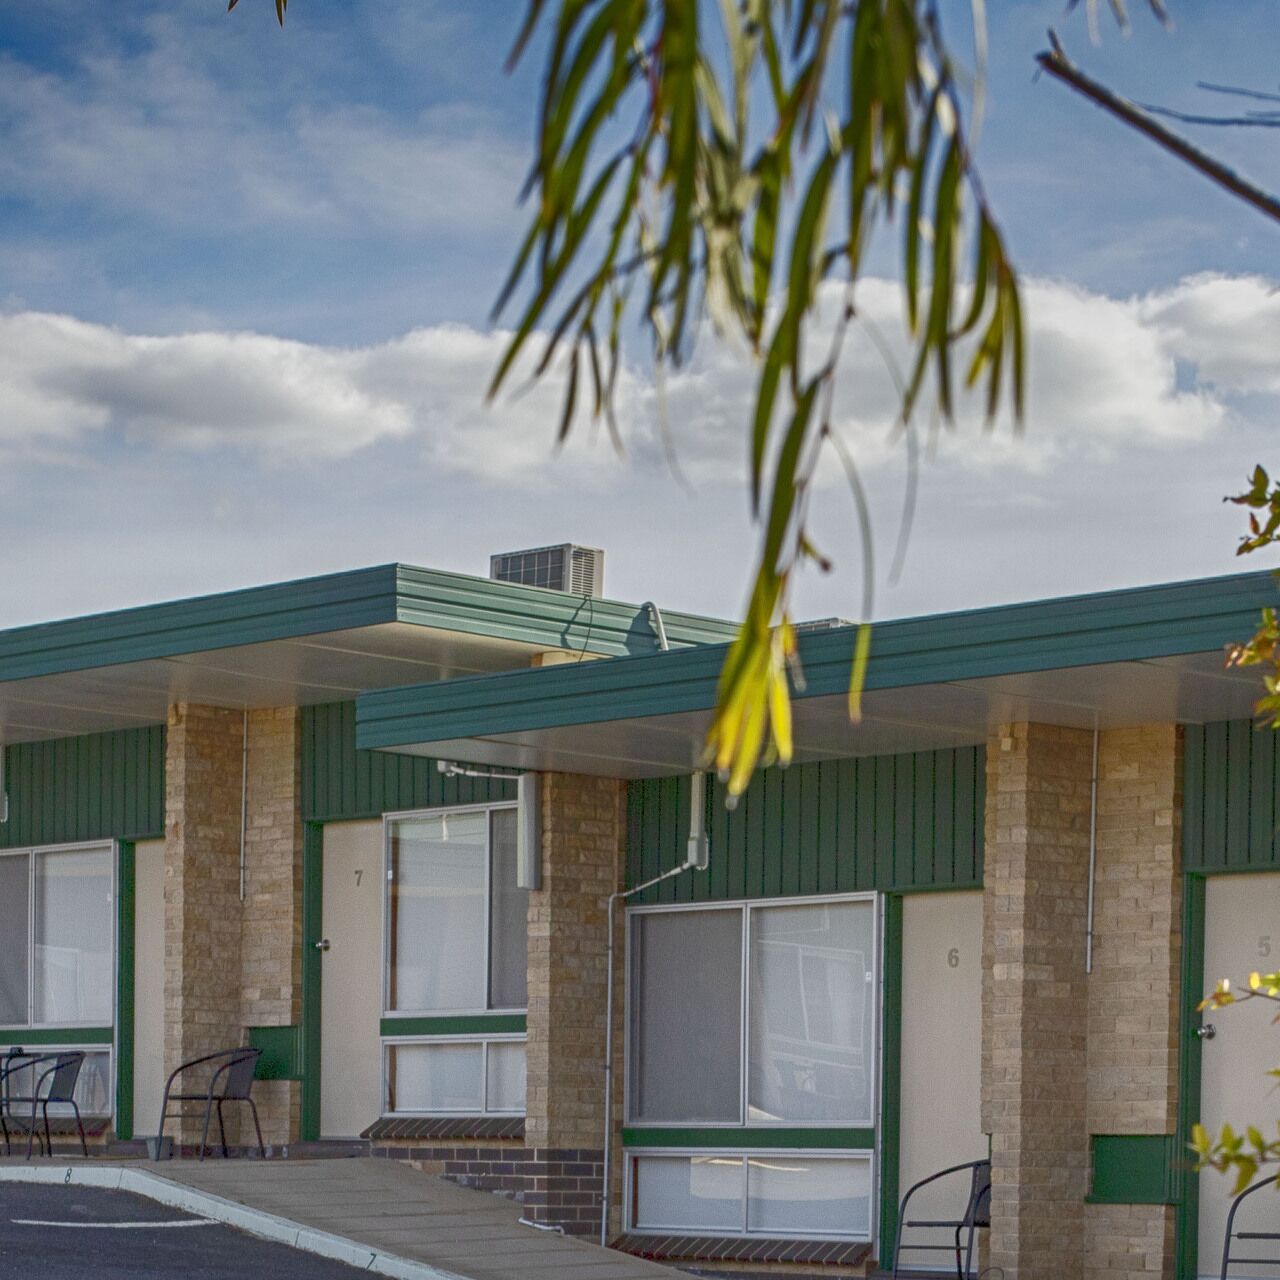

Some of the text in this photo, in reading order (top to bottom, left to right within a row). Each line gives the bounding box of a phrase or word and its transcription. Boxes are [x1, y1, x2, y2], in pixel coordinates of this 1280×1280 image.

[354, 869, 364, 887] 7
[1258, 935, 1271, 957] 5
[947, 947, 960, 969] 6
[64, 1167, 73, 1184] 8
[366, 1252, 377, 1270] 7
